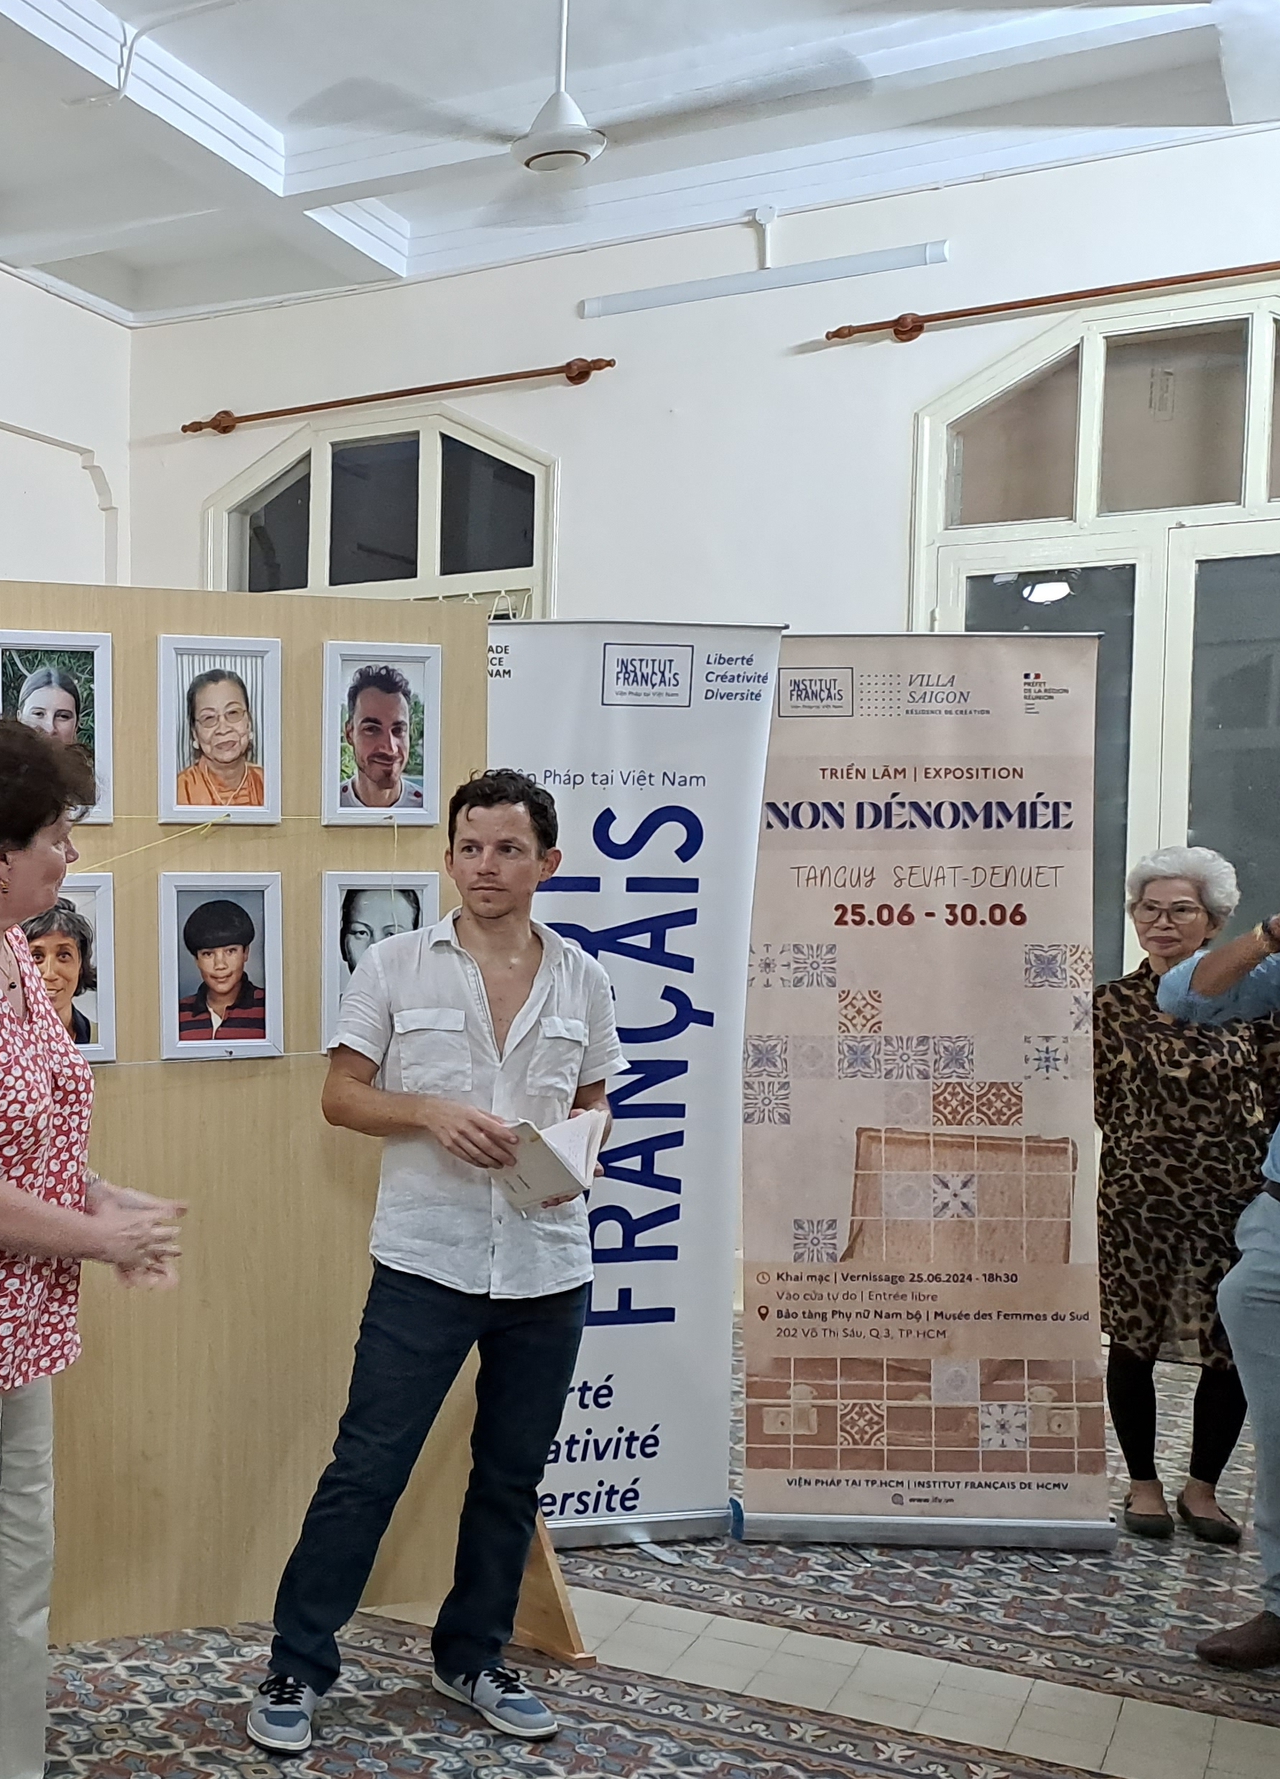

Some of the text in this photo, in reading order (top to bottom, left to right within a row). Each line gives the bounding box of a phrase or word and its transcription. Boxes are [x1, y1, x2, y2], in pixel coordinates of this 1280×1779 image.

[616, 657, 675, 673] INSTITUT
[706, 653, 754, 666] Liberté
[705, 671, 769, 684] Créativité
[790, 678, 838, 691] INSTITUT
[908, 674, 956, 687] VILLA
[704, 688, 762, 701] Diversité
[907, 690, 971, 704] SAIGON
[819, 762, 867, 780] TRIỂN
[872, 764, 907, 780] LÃM
[923, 767, 1024, 780] EXPOSITION
[543, 768, 585, 790] Pháp
[591, 768, 615, 791] tại
[619, 769, 655, 791] Việt
[661, 770, 707, 787] Nam
[764, 791, 1074, 830] NON DÉNOMMÉE
[833, 903, 916, 927] 25.06
[944, 903, 1028, 927] 30.06
[776, 1271, 803, 1282] Khai
[806, 1274, 830, 1285] mạc
[841, 1271, 906, 1285] Vernissage
[908, 1272, 972, 1284] 25.06.2024
[982, 1272, 1018, 1284] 18h30
[842, 1290, 857, 1301] do
[868, 1290, 908, 1301] Entrée
[911, 1291, 938, 1302] libre
[831, 1309, 852, 1322] Phụ
[873, 1309, 902, 1320] Nam
[906, 1309, 922, 1323] bộ
[934, 1310, 970, 1321] Musée
[973, 1310, 993, 1321] des
[997, 1310, 1047, 1322] Femmes
[1051, 1311, 1066, 1322] du
[1069, 1310, 1090, 1322] Sud
[776, 1327, 798, 1338] 202
[898, 1328, 947, 1339] TP.HCM
[913, 1480, 961, 1489] INSTITUT
[964, 1481, 1017, 1491] FRANÇAIS
[1020, 1481, 1032, 1490] DE
[1036, 1482, 1069, 1491] HCMV
[539, 1477, 641, 1518] ersité
